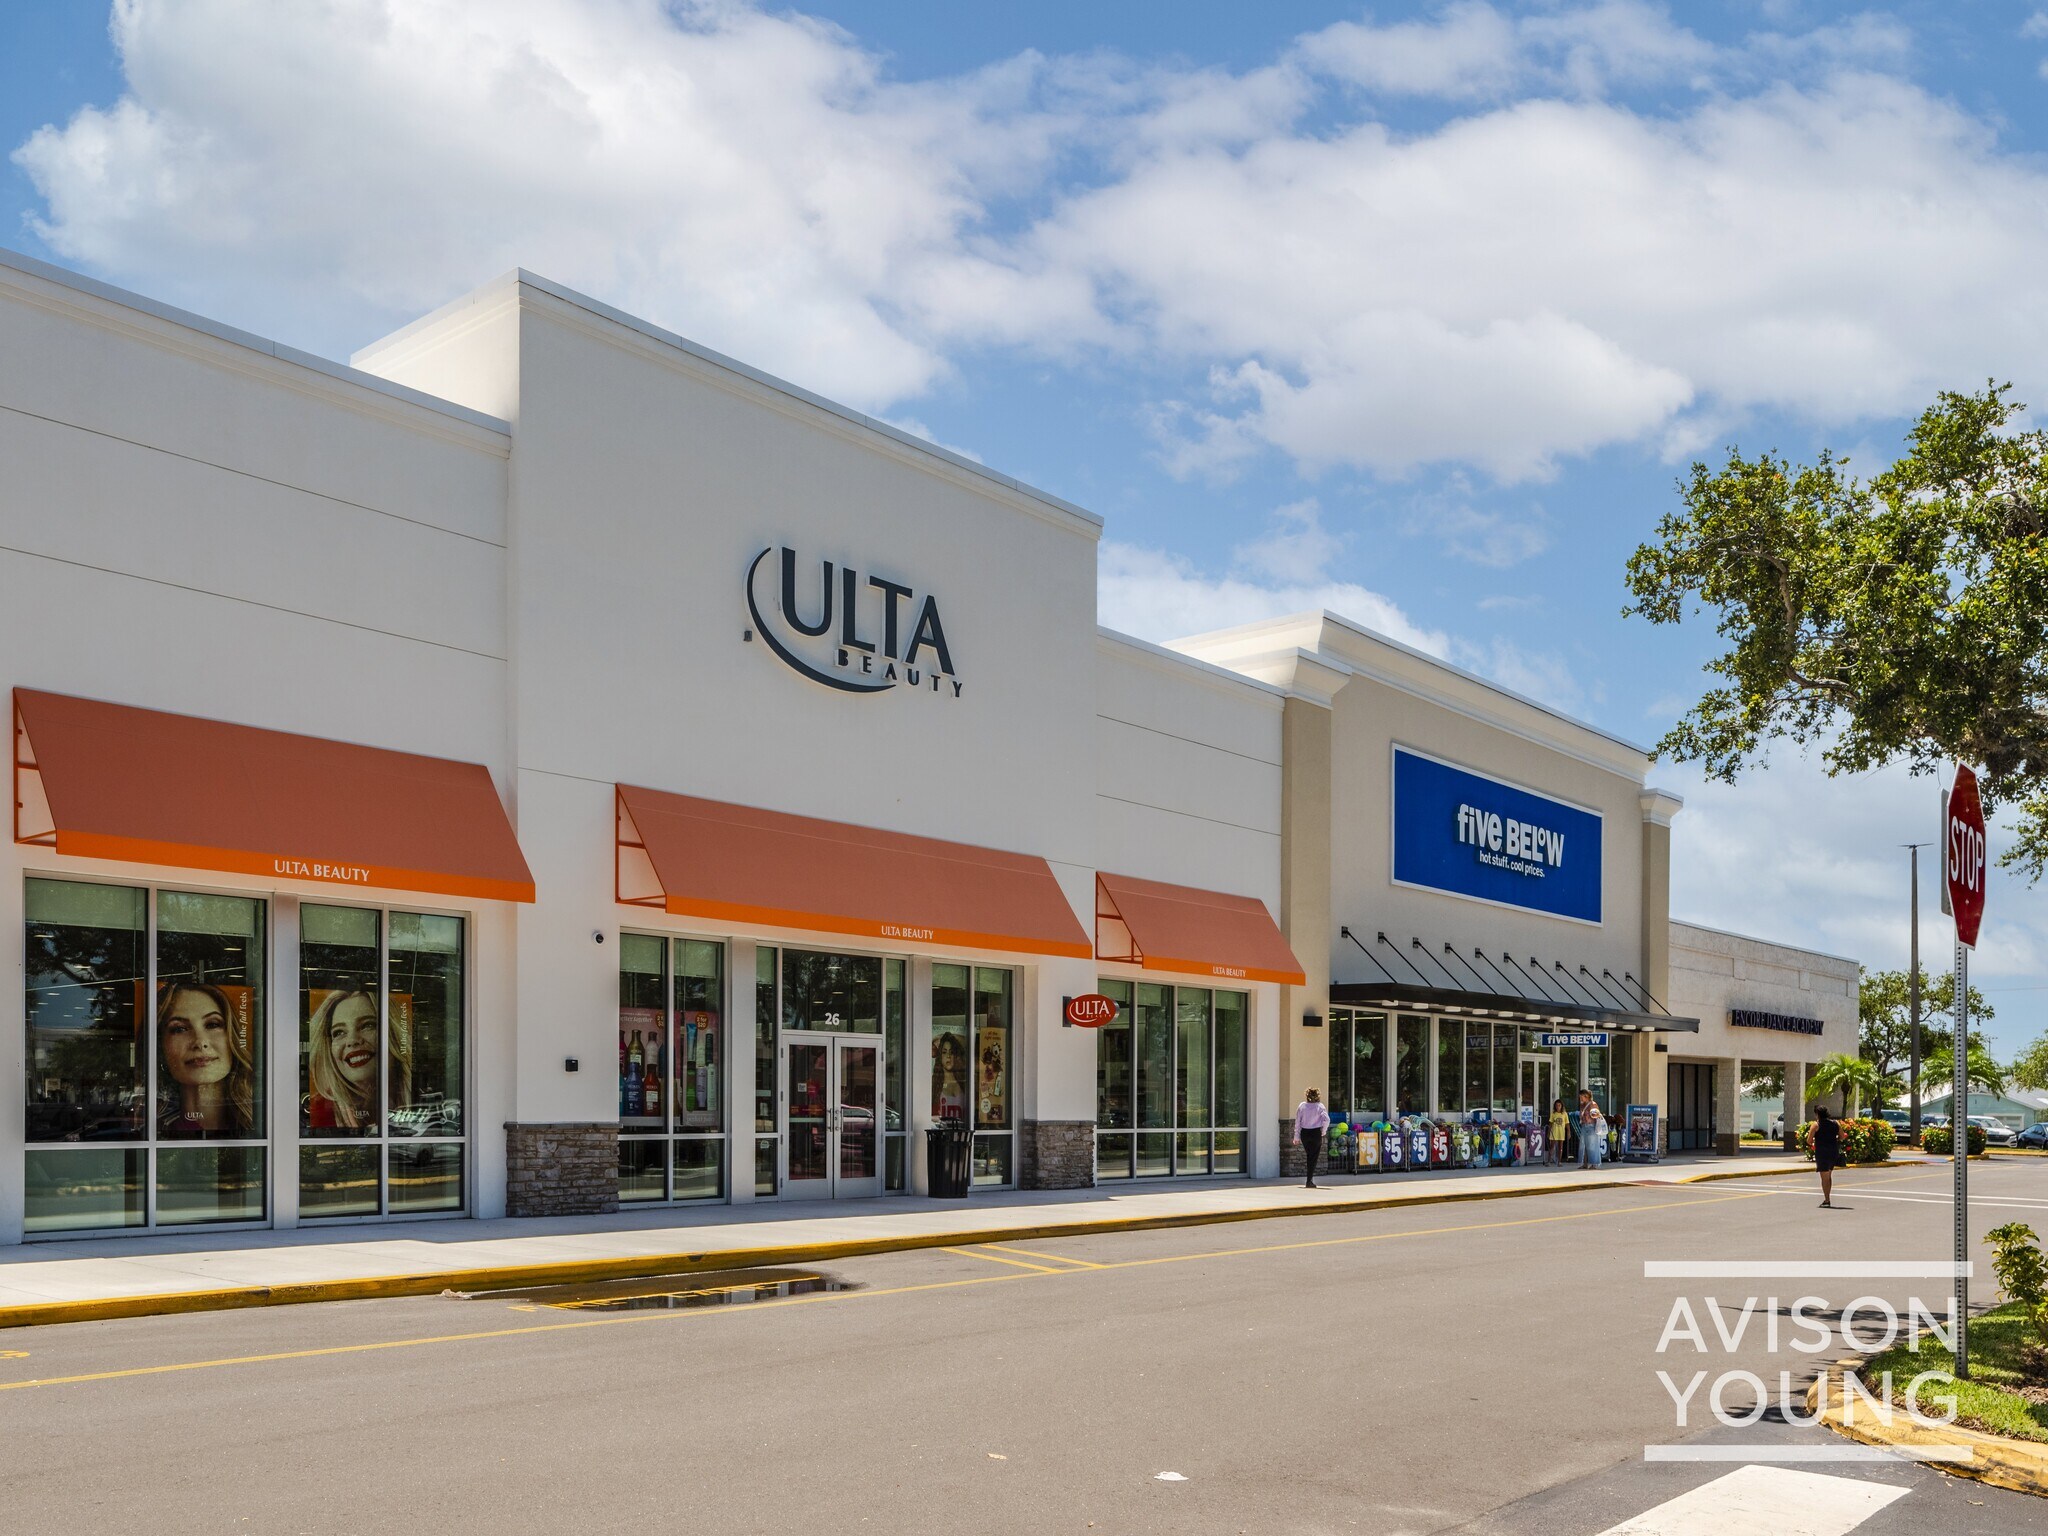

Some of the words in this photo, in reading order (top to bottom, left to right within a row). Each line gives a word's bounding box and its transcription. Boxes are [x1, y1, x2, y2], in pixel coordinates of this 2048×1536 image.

[779, 546, 956, 676] ULTA
[835, 649, 962, 698] BEAUTY
[1458, 804, 1502, 851] five
[1479, 850, 1491, 864] hot
[1492, 853, 1510, 869] stuff.
[1510, 861, 1524, 873] cool
[1524, 863, 1545, 877] prices.
[1951, 816, 1984, 892] STOP
[274, 859, 310, 876] ULTA
[313, 864, 370, 882] BEAUTY
[881, 925, 901, 937] ULTA
[902, 927, 934, 940] BEAUTY
[1212, 965, 1226, 975] ULTA
[1225, 967, 1247, 978] BEAUTY
[825, 1012, 840, 1026] 26
[1075, 1000, 1110, 1015] ULTA
[1734, 1009, 1766, 1028] ENCORE
[1766, 1012, 1791, 1032] DANCE
[1791, 1016, 1824, 1036] ACADEMY
[1547, 1035, 1568, 1044] five
[187, 1111, 204, 1119] ULTA
[1360, 1137, 1377, 1164] $5
[1384, 1137, 1402, 1163] $5
[1412, 1136, 1427, 1162] $5
[1433, 1136, 1448, 1160] $5
[1530, 1133, 1542, 1156] $2
